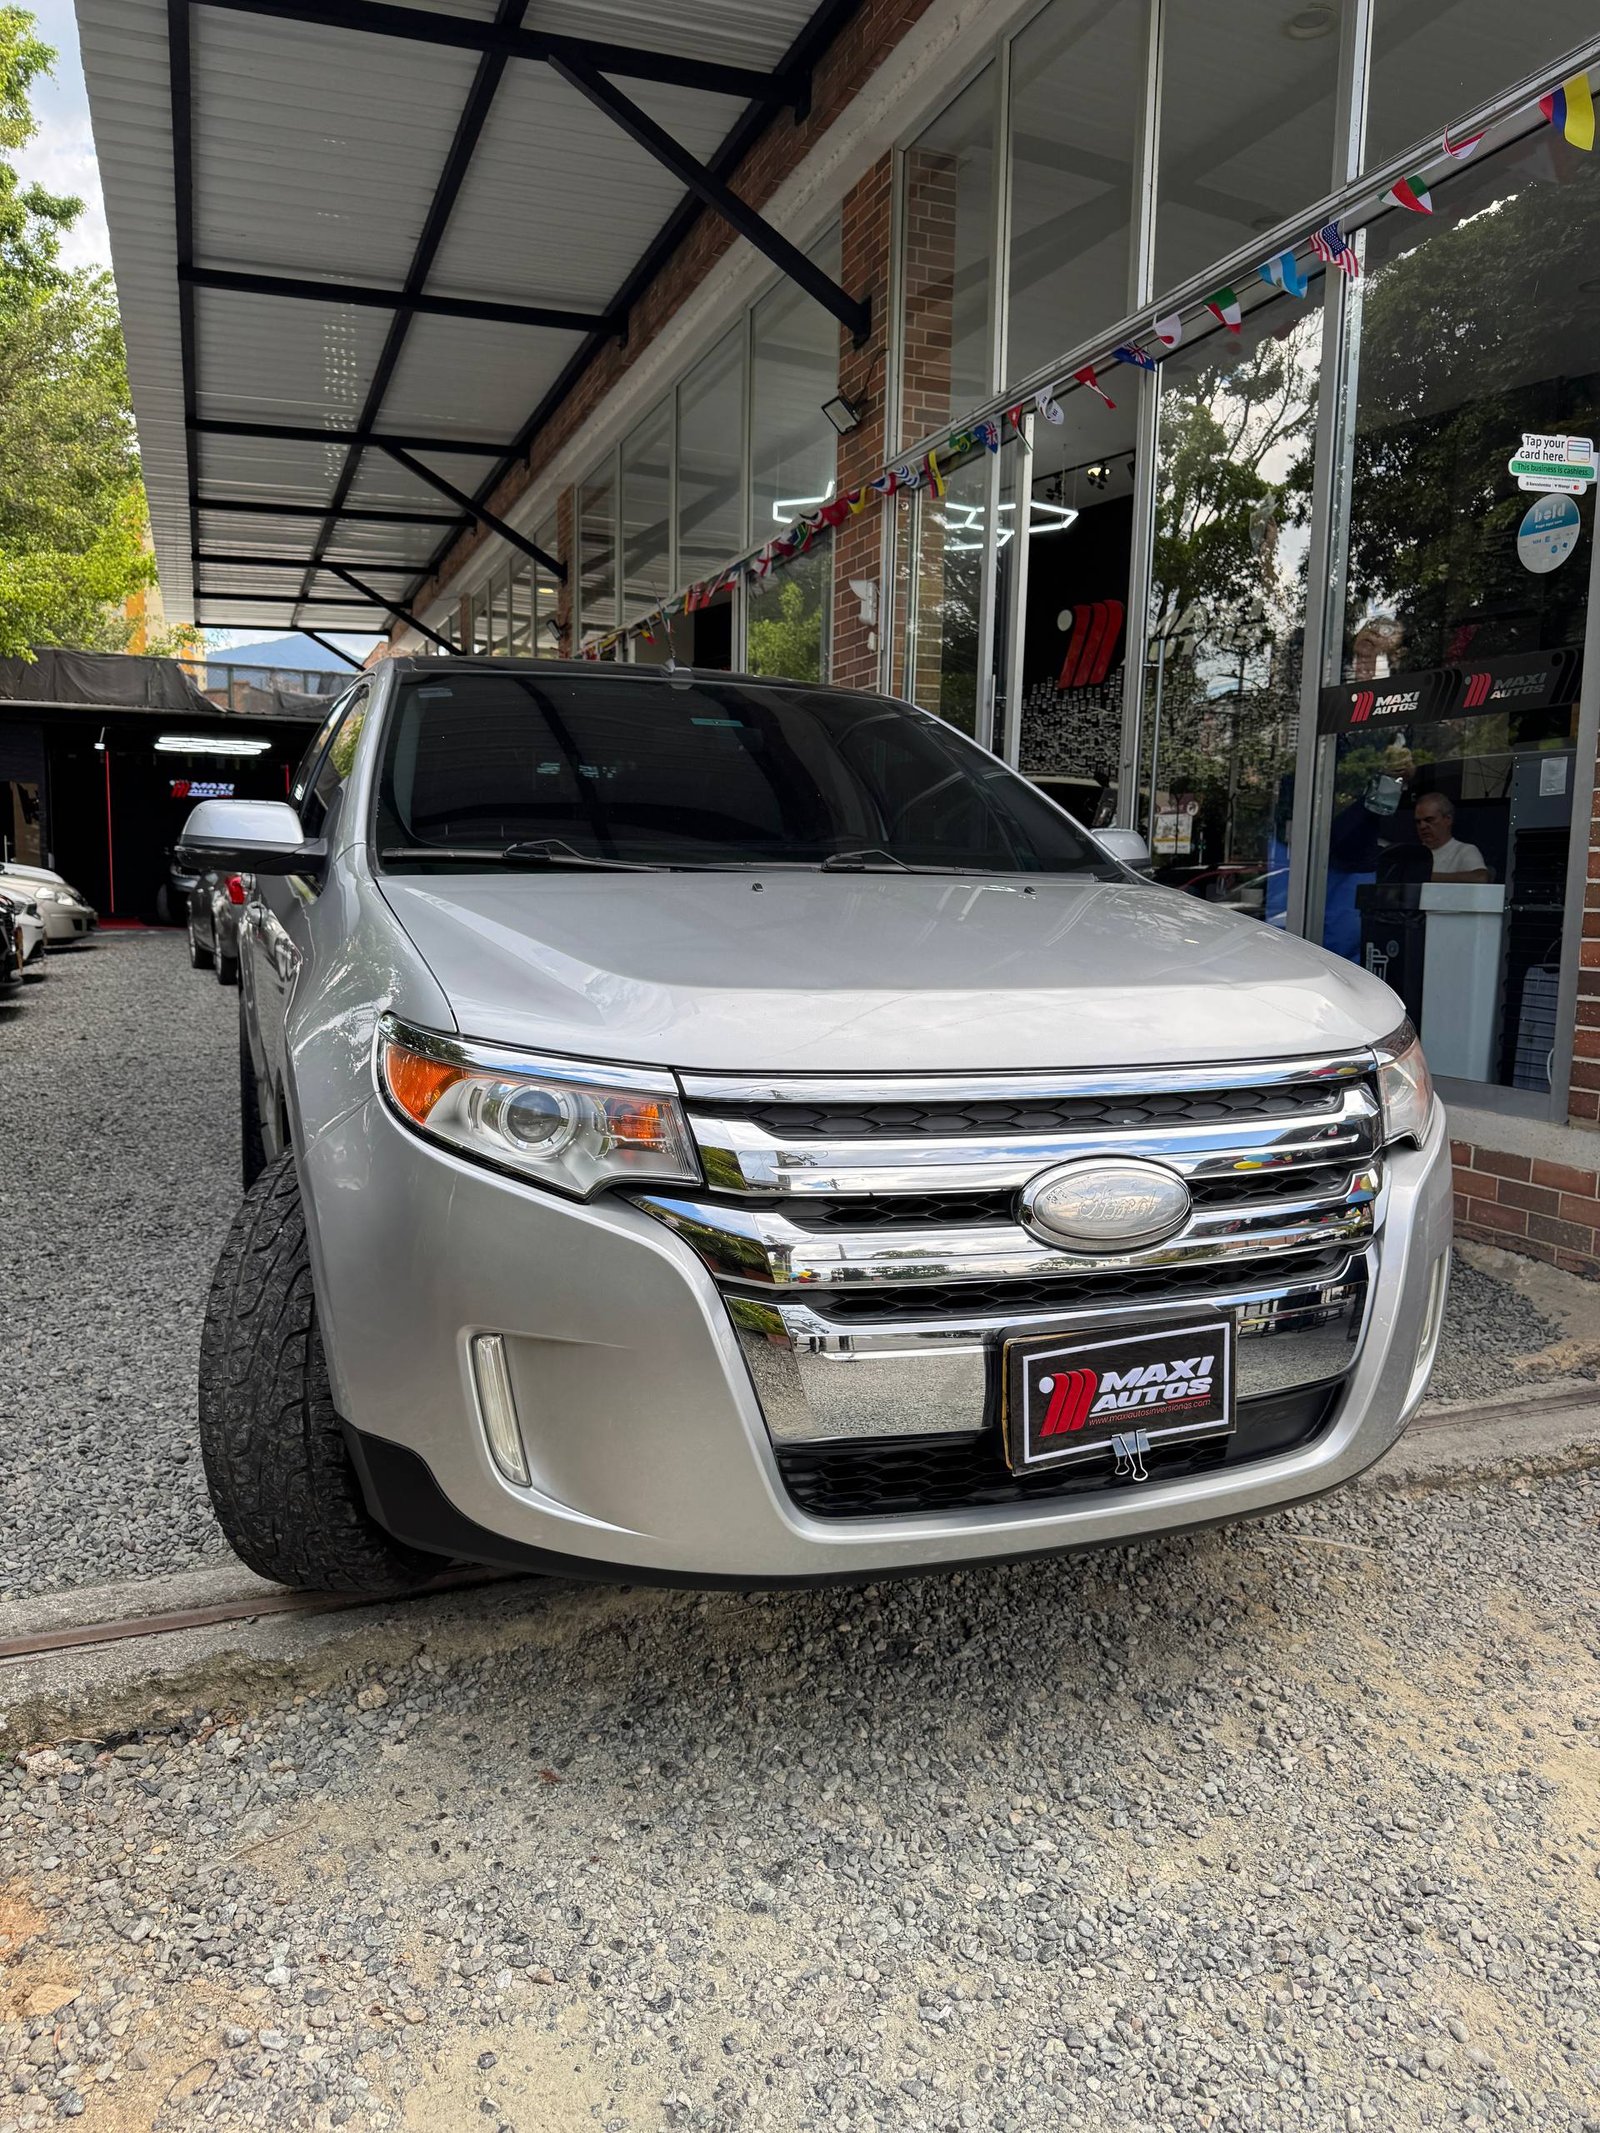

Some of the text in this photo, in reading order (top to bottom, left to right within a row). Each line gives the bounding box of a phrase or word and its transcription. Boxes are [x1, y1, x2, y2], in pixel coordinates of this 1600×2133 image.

[1525, 436, 1565, 449] Tap your
[1520, 450, 1566, 462] card here.
[1517, 463, 1590, 476] This business is cashless.
[1534, 503, 1566, 523] bold
[1495, 672, 1547, 690] MAXI
[1375, 691, 1421, 707] MAXI
[1490, 684, 1545, 699] AUTOS
[1372, 702, 1418, 716] AUTOS
[190, 782, 235, 791] MAXI
[1099, 1355, 1215, 1393] MAXI
[1091, 1377, 1213, 1413] AUTOS
